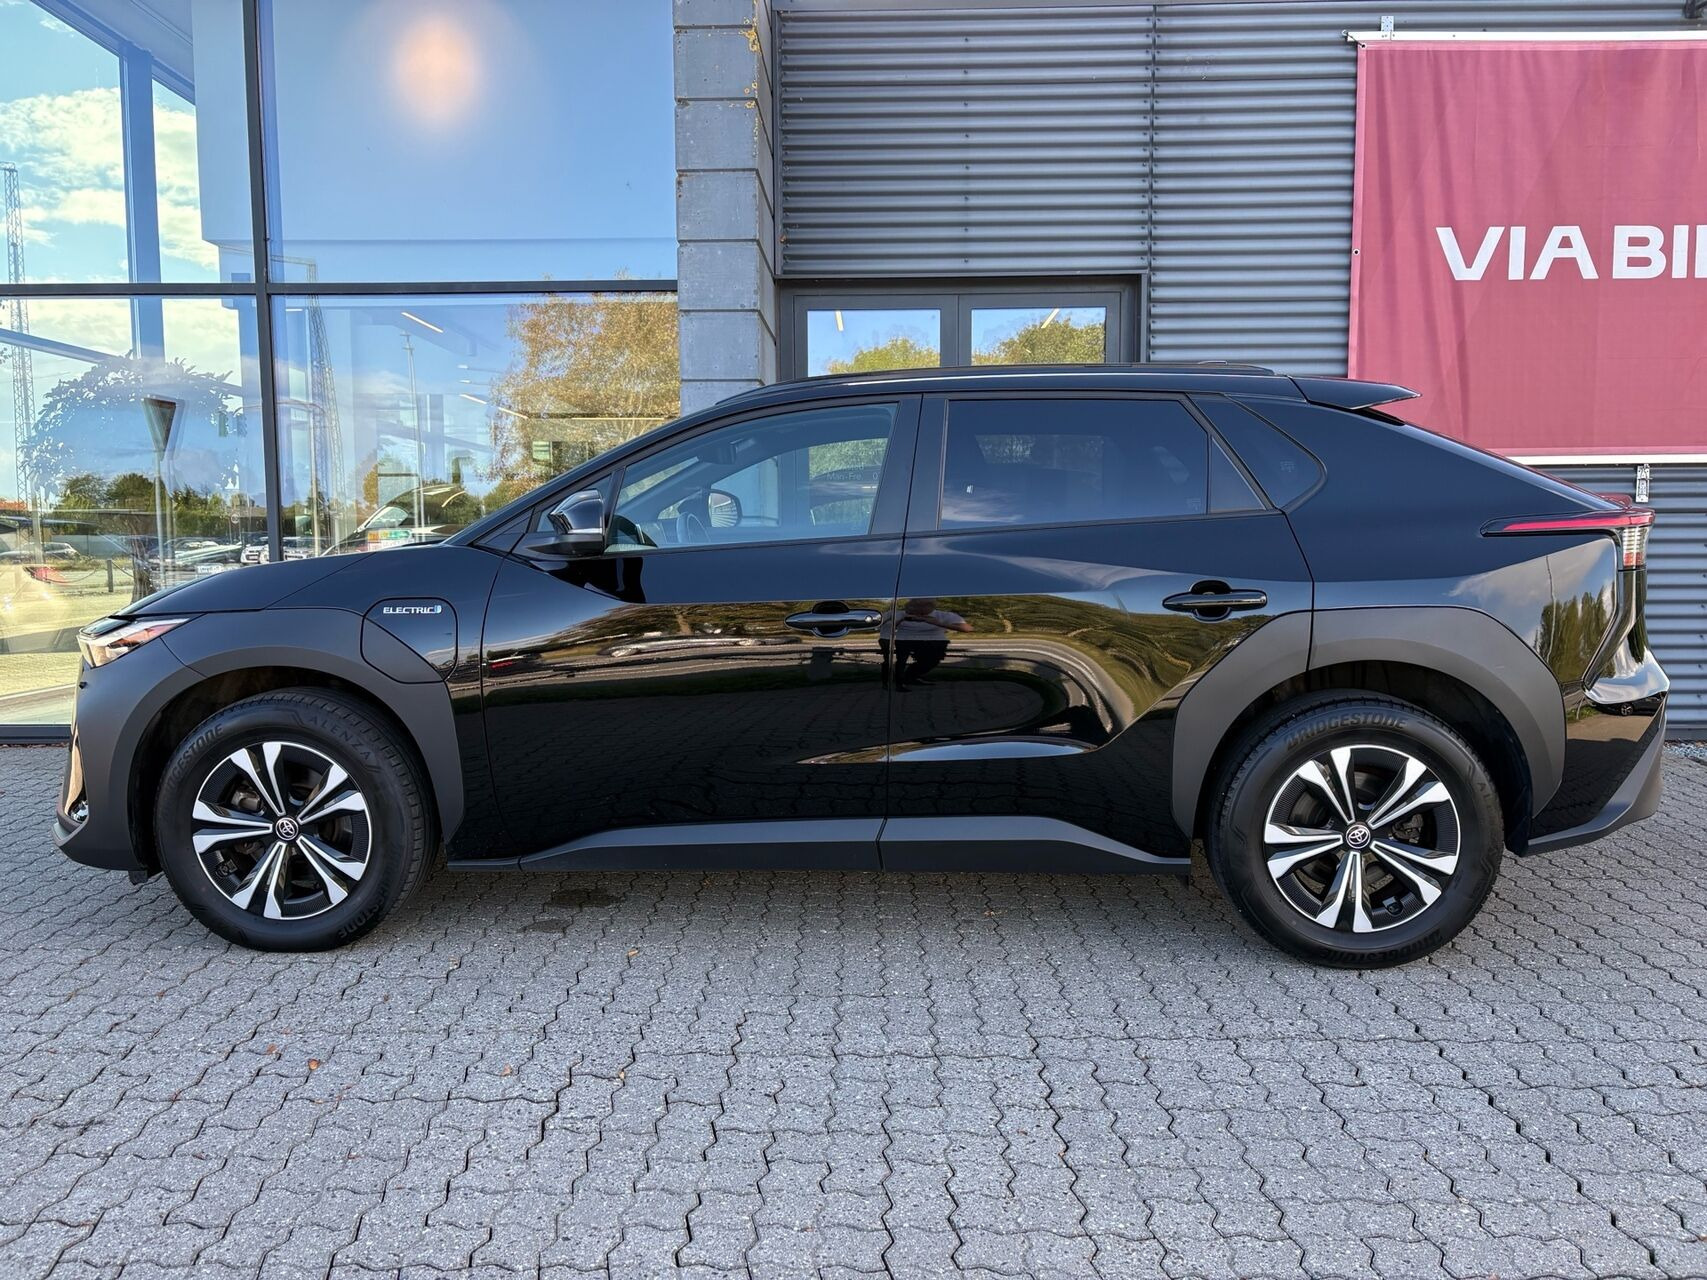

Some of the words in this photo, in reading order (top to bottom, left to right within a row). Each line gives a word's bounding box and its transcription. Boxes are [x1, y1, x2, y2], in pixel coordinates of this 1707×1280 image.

[1436, 225, 1600, 281] VIA
[383, 606, 436, 615] ELECTRIC
[309, 715, 371, 760] ALENZA
